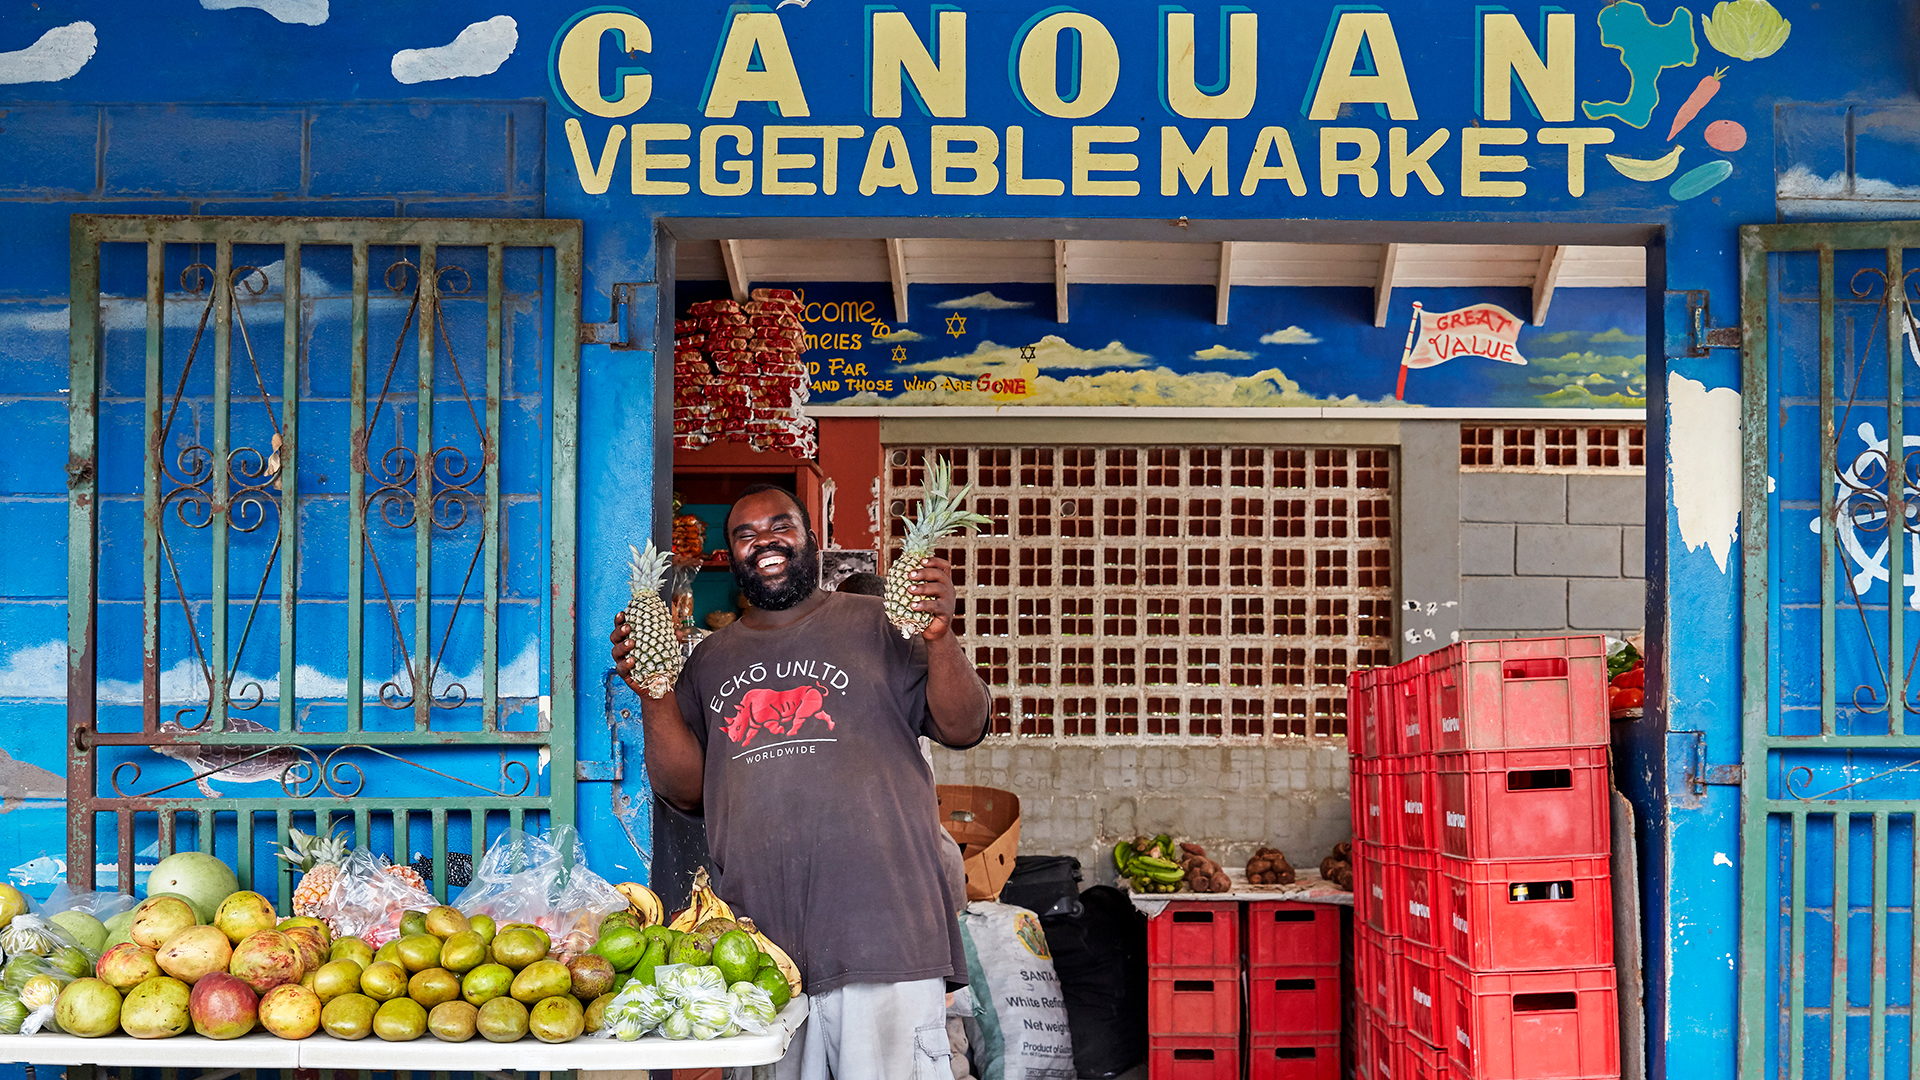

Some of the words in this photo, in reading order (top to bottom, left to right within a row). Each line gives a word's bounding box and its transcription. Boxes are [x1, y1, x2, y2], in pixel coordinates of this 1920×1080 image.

[552, 6, 1576, 122] CANOUAN
[565, 118, 1141, 196] VEGETABLE
[1160, 126, 1616, 198] MARKET
[871, 317, 891, 338] to
[1436, 309, 1513, 333] GREAT
[1428, 333, 1514, 362] VALUE
[828, 358, 869, 377] FAR
[811, 380, 840, 393] AND
[845, 378, 893, 392] THOSE
[903, 375, 937, 392] WHO
[941, 377, 973, 392] ARE
[977, 373, 1027, 395] GONE
[775, 659, 850, 697] UNLTD.
[745, 745, 816, 765] WORLDWIDE
[1020, 970, 1054, 981] SANTA
[1005, 996, 1040, 1008] White
[1023, 1019, 1044, 1031] Net
[1022, 1041, 1052, 1053] Product
